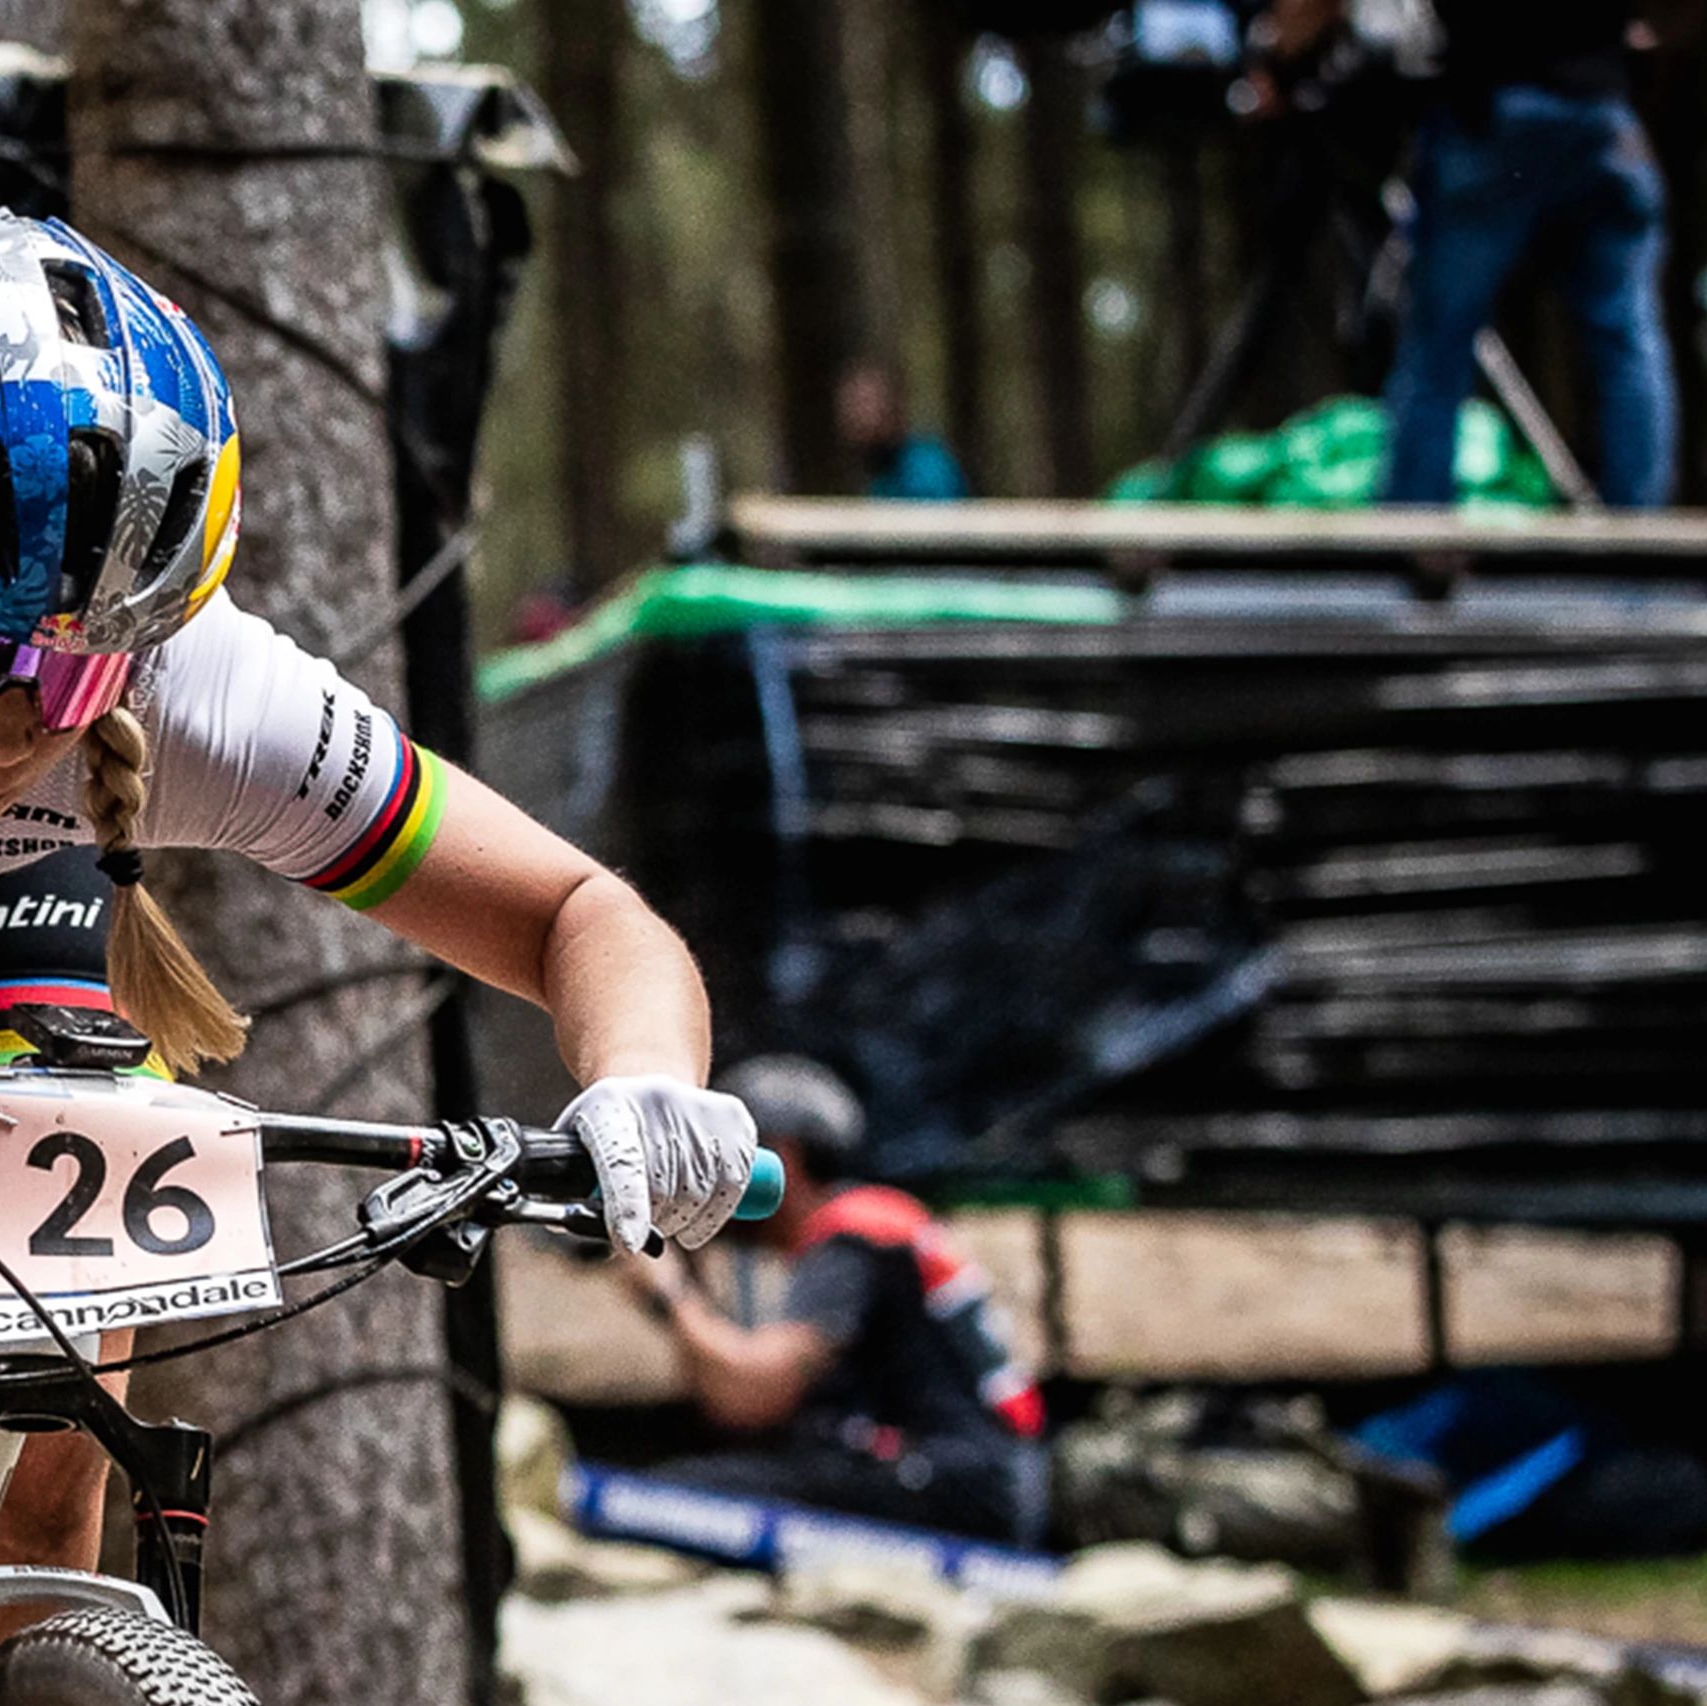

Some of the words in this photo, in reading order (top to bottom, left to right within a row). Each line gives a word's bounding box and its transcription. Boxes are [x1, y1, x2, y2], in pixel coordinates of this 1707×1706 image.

[293, 687, 336, 801] TREK
[324, 709, 373, 822] ROCKSHOX
[25, 1131, 216, 1257] 26
